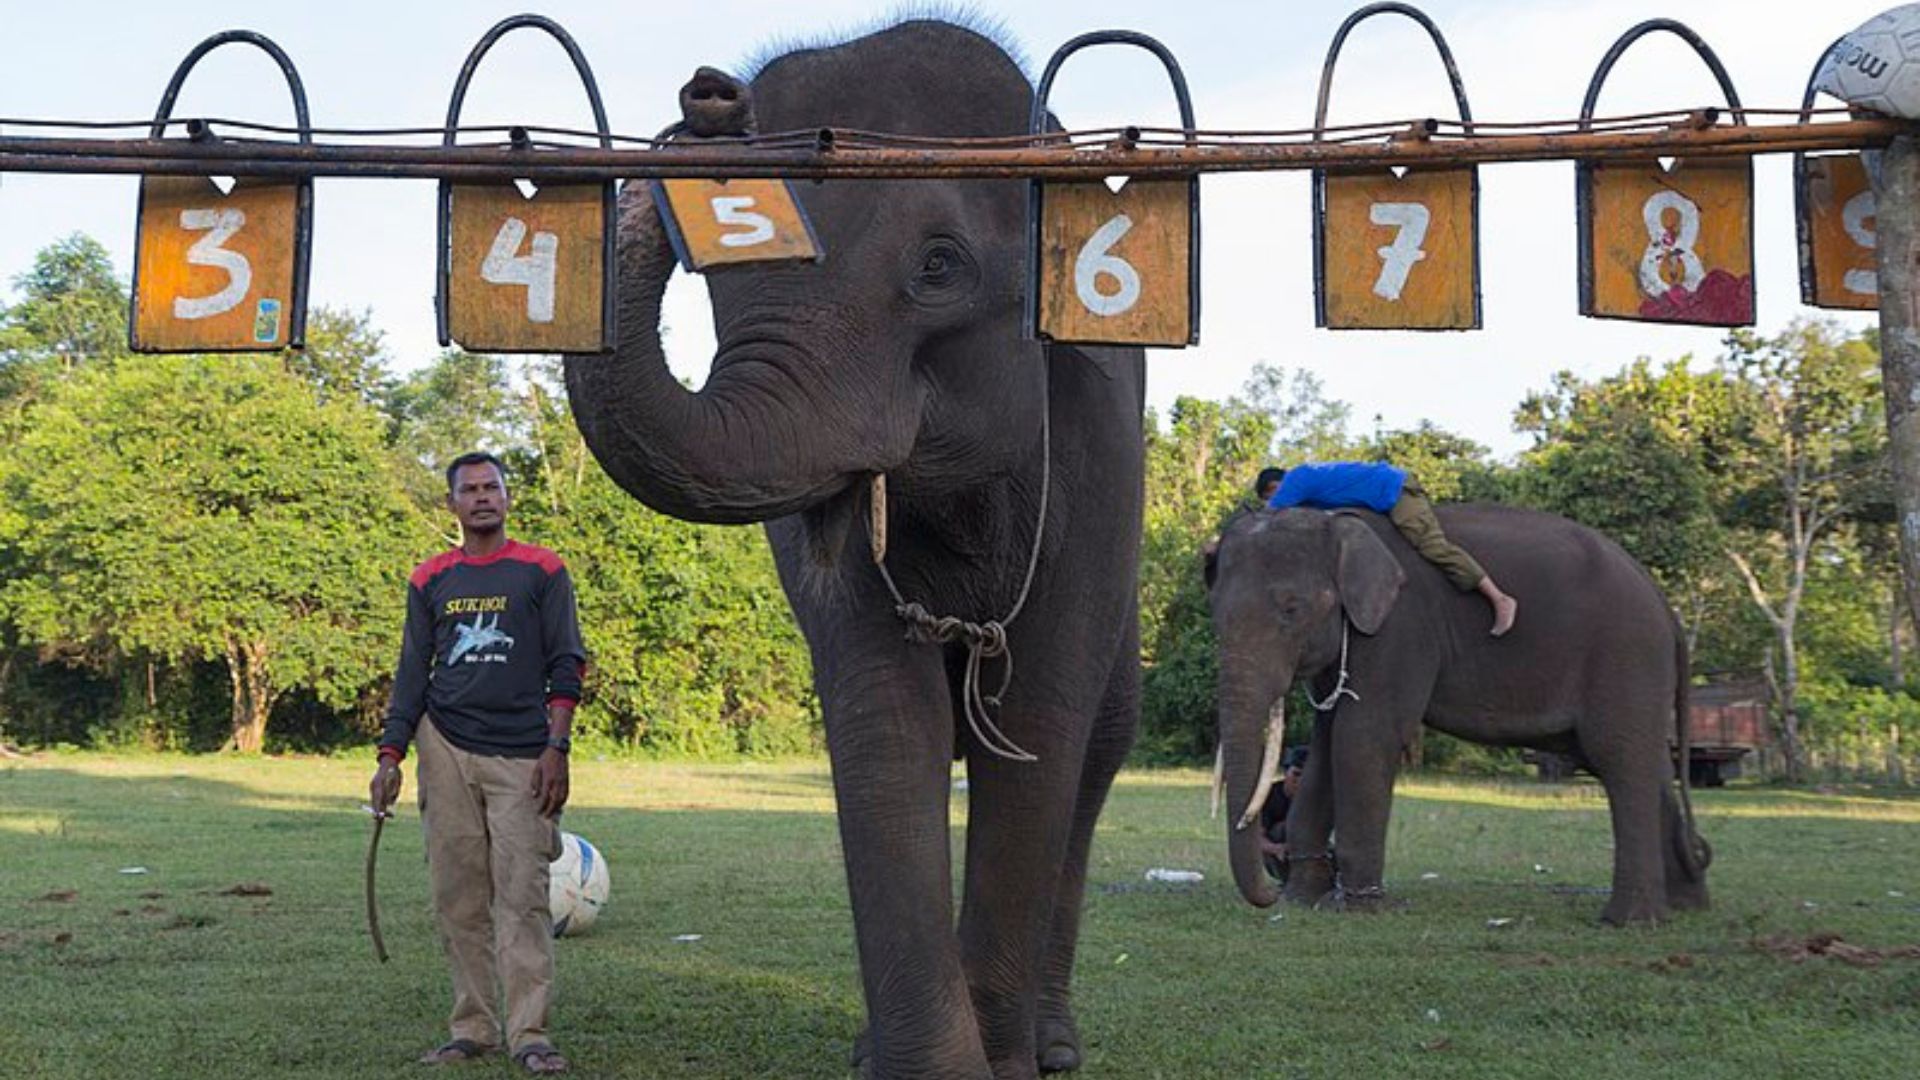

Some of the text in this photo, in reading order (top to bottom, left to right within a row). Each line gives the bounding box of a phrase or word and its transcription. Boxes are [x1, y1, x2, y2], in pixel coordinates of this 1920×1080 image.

[173, 208, 252, 319] 3
[480, 217, 558, 323] 4
[711, 196, 774, 247] 5
[1074, 213, 1141, 316] 6
[1369, 202, 1430, 300] 7
[1639, 190, 1705, 299] 8
[446, 597, 507, 614] SUKHOI
